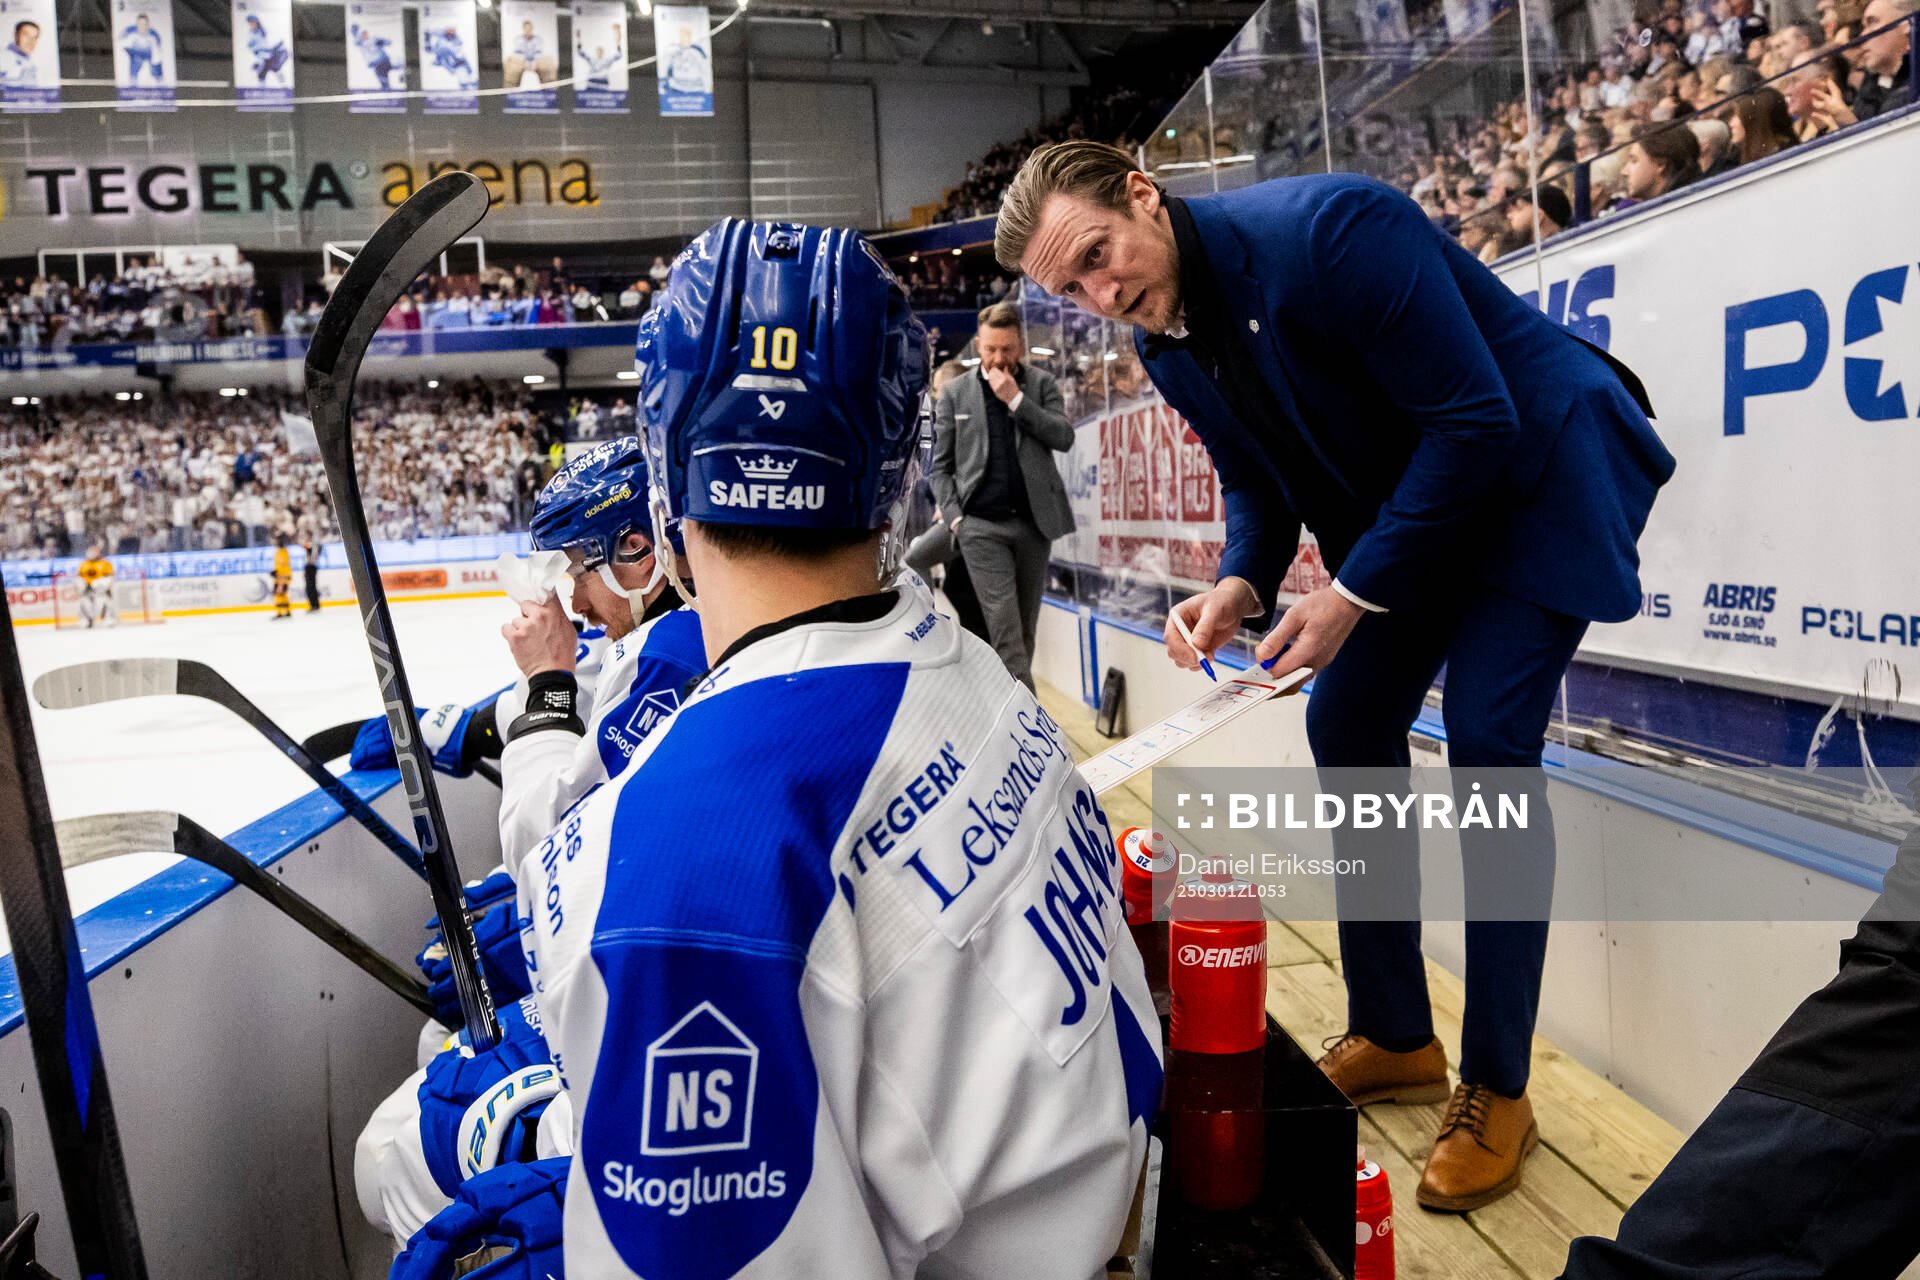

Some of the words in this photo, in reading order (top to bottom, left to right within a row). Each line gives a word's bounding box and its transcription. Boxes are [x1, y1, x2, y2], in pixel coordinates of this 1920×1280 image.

[25, 161, 355, 217] TEGERA
[750, 325, 798, 371] 10
[584, 487, 632, 519] dalaenergi
[709, 479, 826, 511] SAFE4U
[1703, 583, 1777, 613] ABRIS
[458, 895, 497, 1022] HYPERLITE
[665, 1067, 734, 1132] NS
[602, 1160, 787, 1217] Skoglunds
